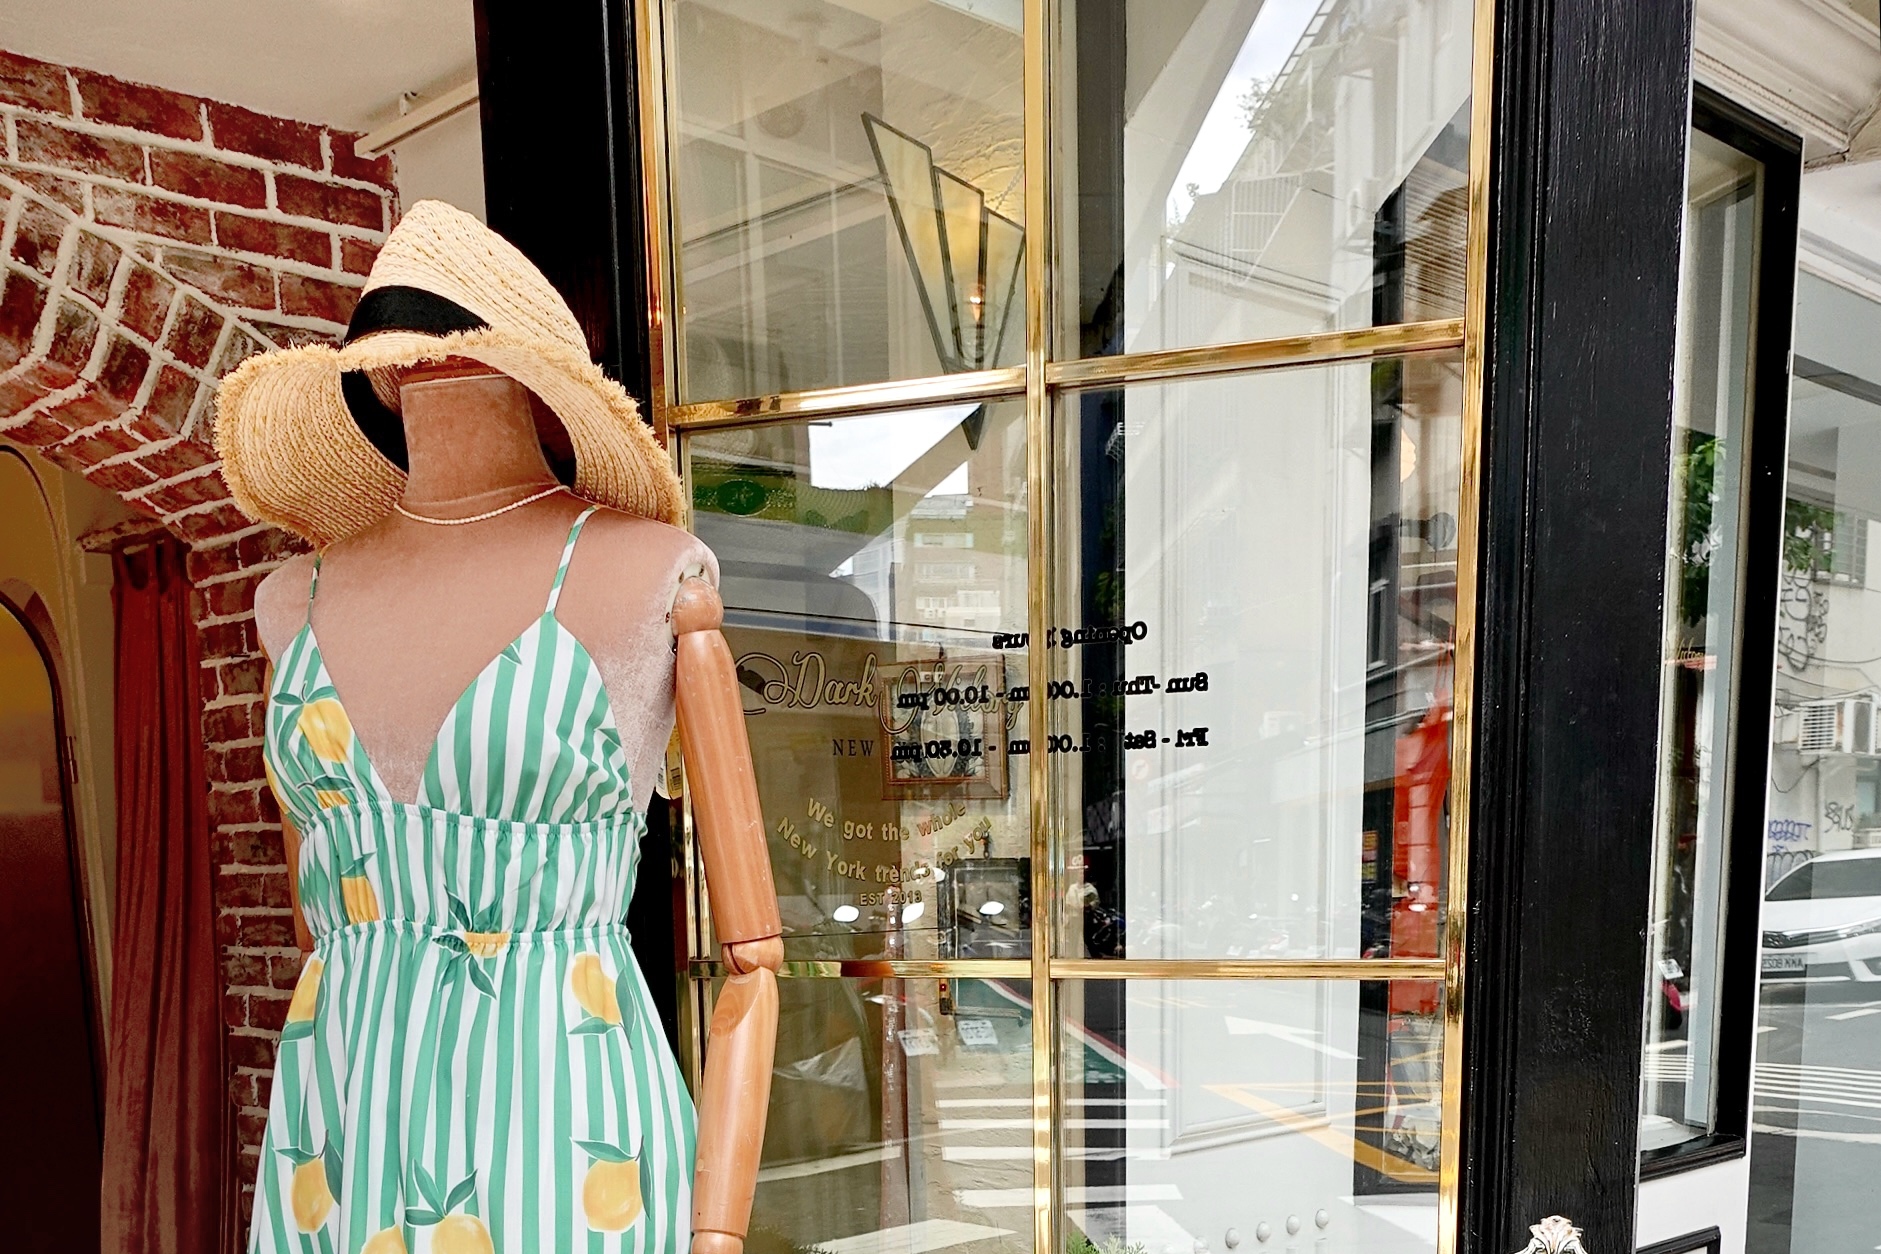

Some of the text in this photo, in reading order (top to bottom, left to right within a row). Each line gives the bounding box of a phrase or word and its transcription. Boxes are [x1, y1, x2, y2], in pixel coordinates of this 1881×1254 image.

[736, 651, 877, 715] Dark
[832, 739, 874, 757] NEW
[807, 797, 966, 841] We got the whole
[777, 815, 992, 884] New York trends for you
[860, 890, 923, 906] EST 2013
